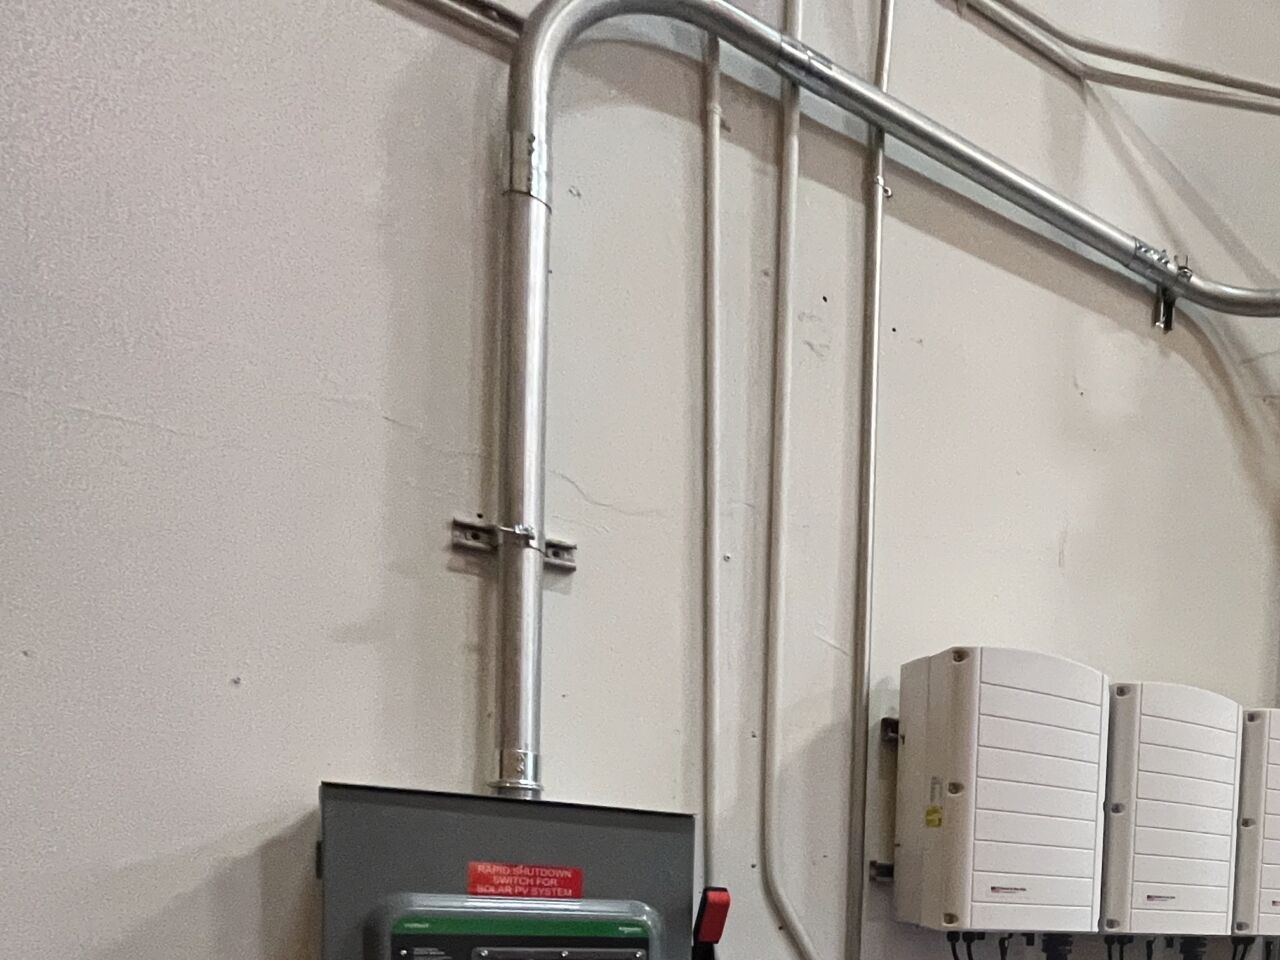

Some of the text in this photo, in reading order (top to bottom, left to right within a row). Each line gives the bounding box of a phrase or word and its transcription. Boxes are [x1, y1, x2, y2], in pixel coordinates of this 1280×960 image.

[477, 864, 572, 877] RAPID SHUTDOWN
[493, 875, 557, 887] SWITCH FOR
[476, 884, 572, 896] SOLAR PV SYSTEM
